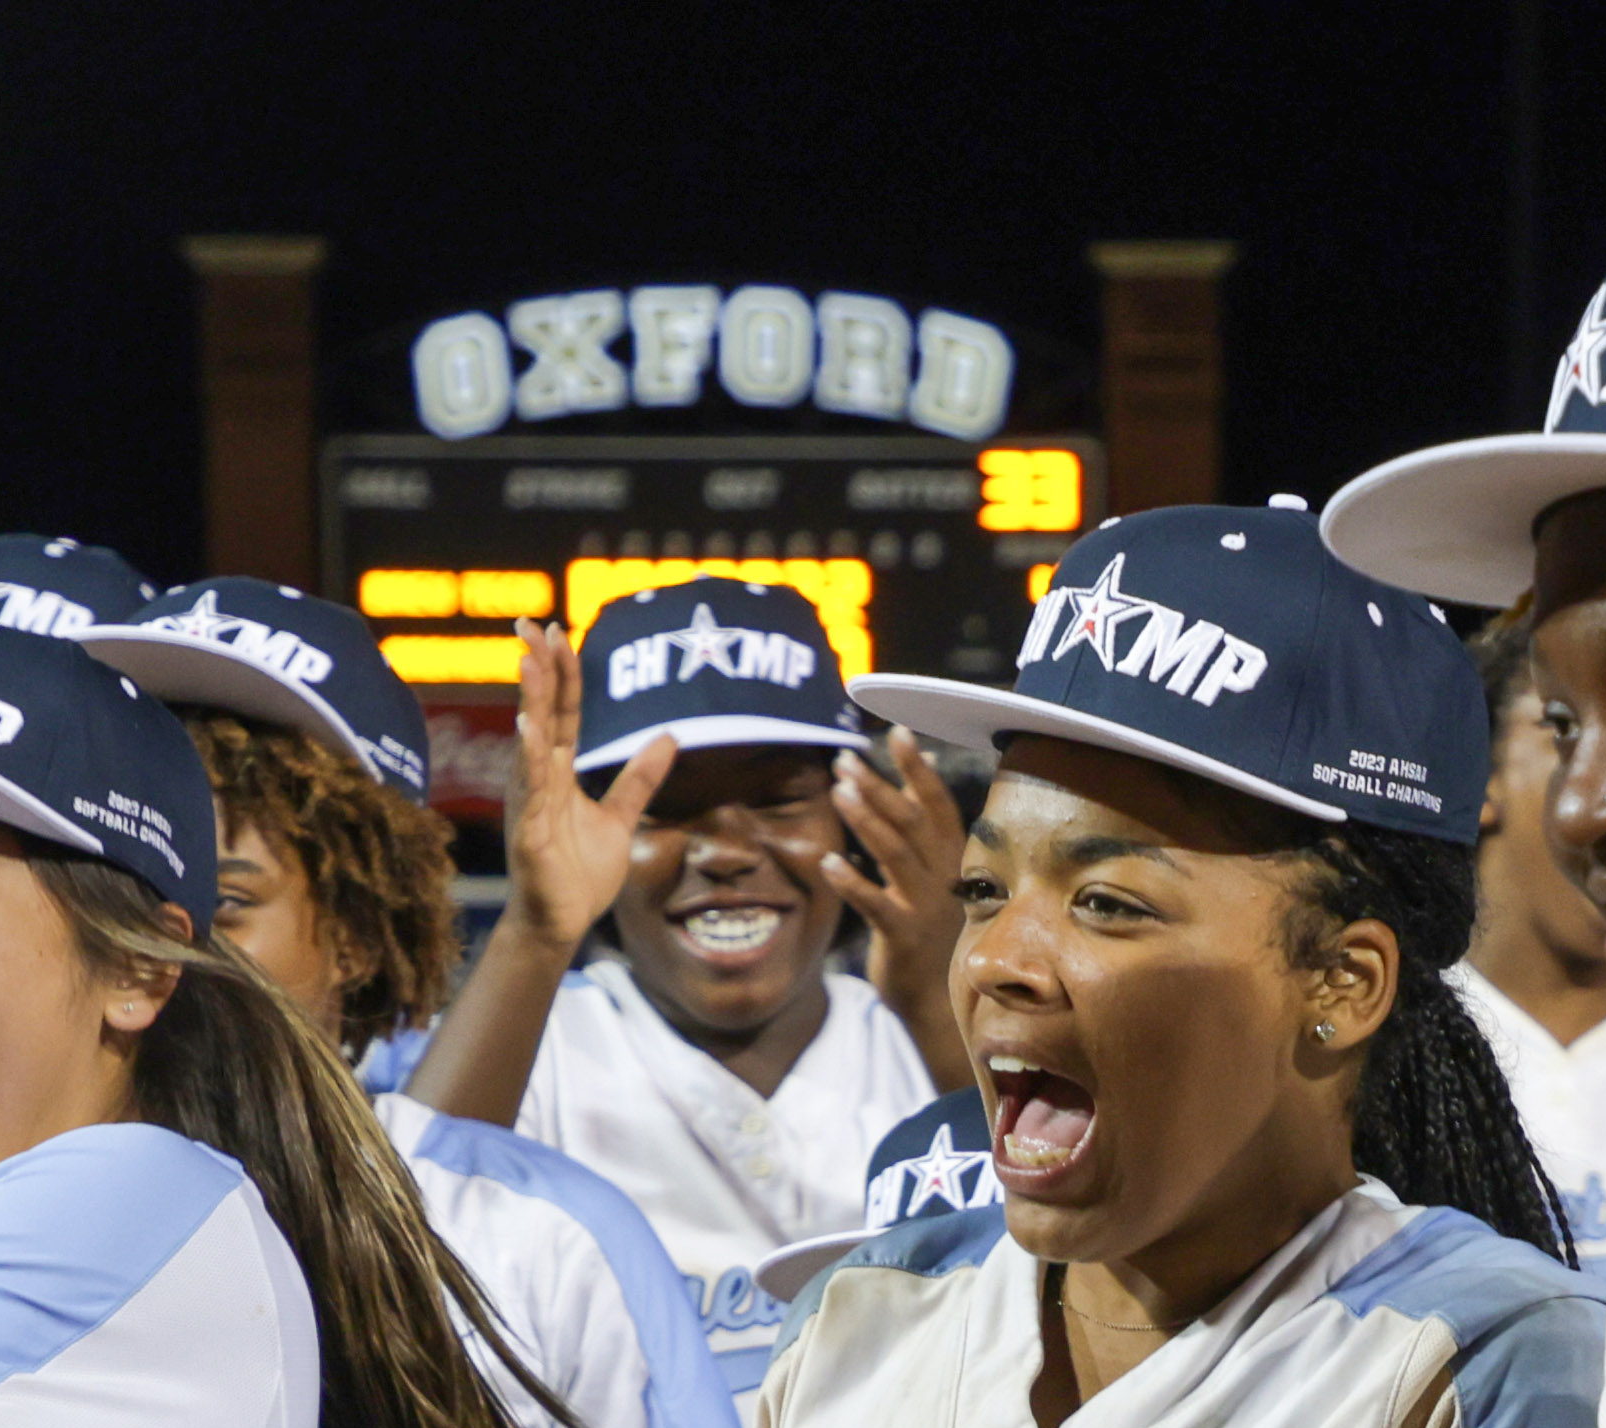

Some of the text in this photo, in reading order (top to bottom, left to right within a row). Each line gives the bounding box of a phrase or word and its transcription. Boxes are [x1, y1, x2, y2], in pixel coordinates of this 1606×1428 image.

[411, 284, 1015, 442] OXFORD
[1312, 763, 1384, 797] SOFTBALL
[1348, 749, 1387, 774] 2023
[73, 796, 138, 839] SOFTBALL
